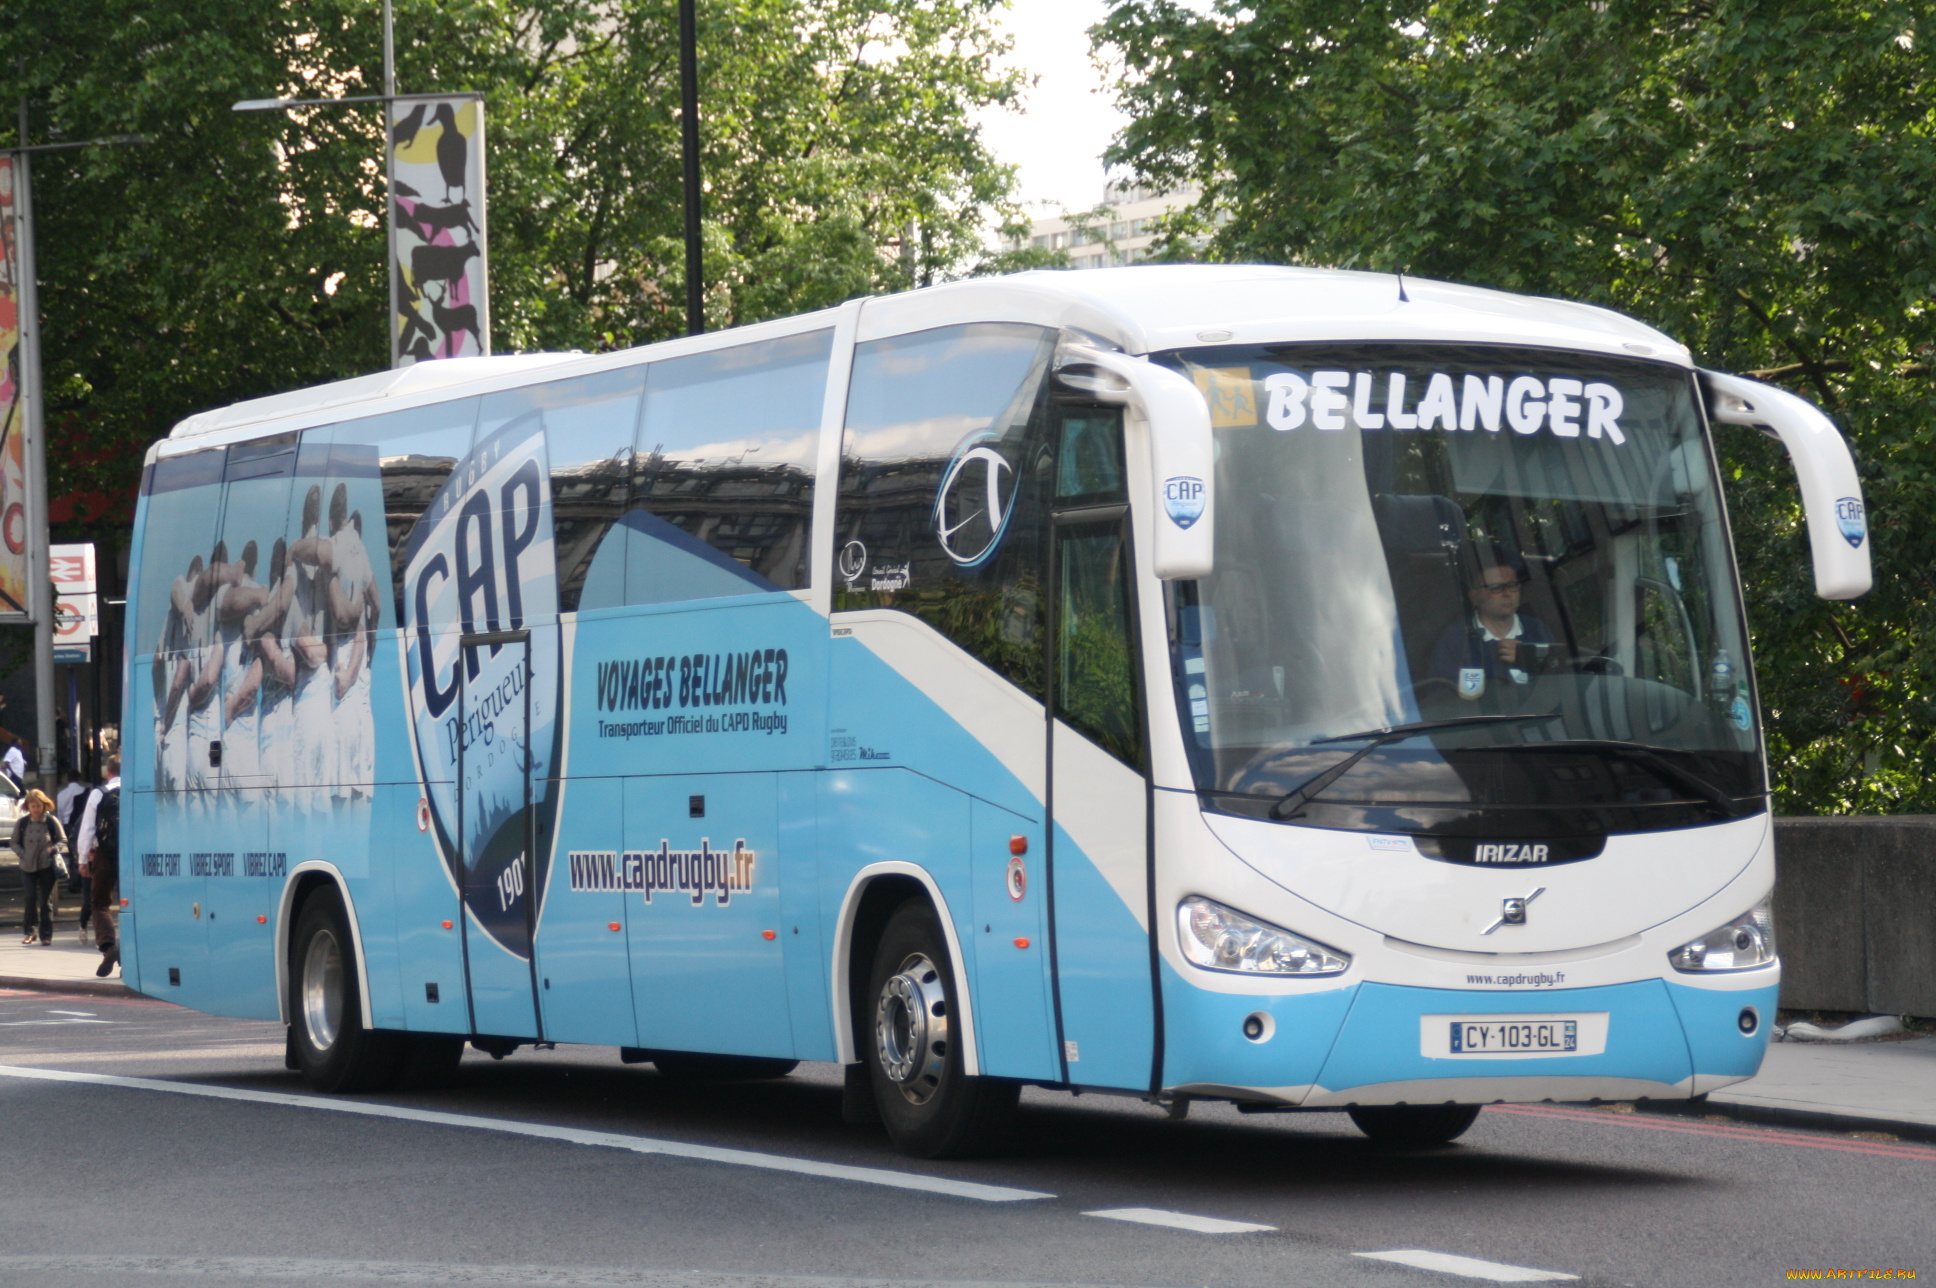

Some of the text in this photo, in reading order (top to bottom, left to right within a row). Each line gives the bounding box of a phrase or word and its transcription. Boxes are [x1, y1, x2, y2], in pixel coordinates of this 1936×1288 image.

[1265, 371, 1625, 445] BELLANGER
[443, 439, 500, 532] RUGBY
[1167, 481, 1203, 500] CAP
[1838, 501, 1863, 520] CAP
[415, 459, 541, 718] CAP
[598, 648, 788, 712] VOYAGES BELLANGER
[598, 711, 787, 741] Transporteur Officiel du CAPD Rugby
[569, 838, 754, 906] www.capdrugby.fr
[1475, 844, 1549, 863] IRIZAR
[497, 851, 526, 911] 190
[1466, 972, 1565, 987] www.capdrugby.fr
[1466, 1026, 1560, 1048] CY-103-GL
